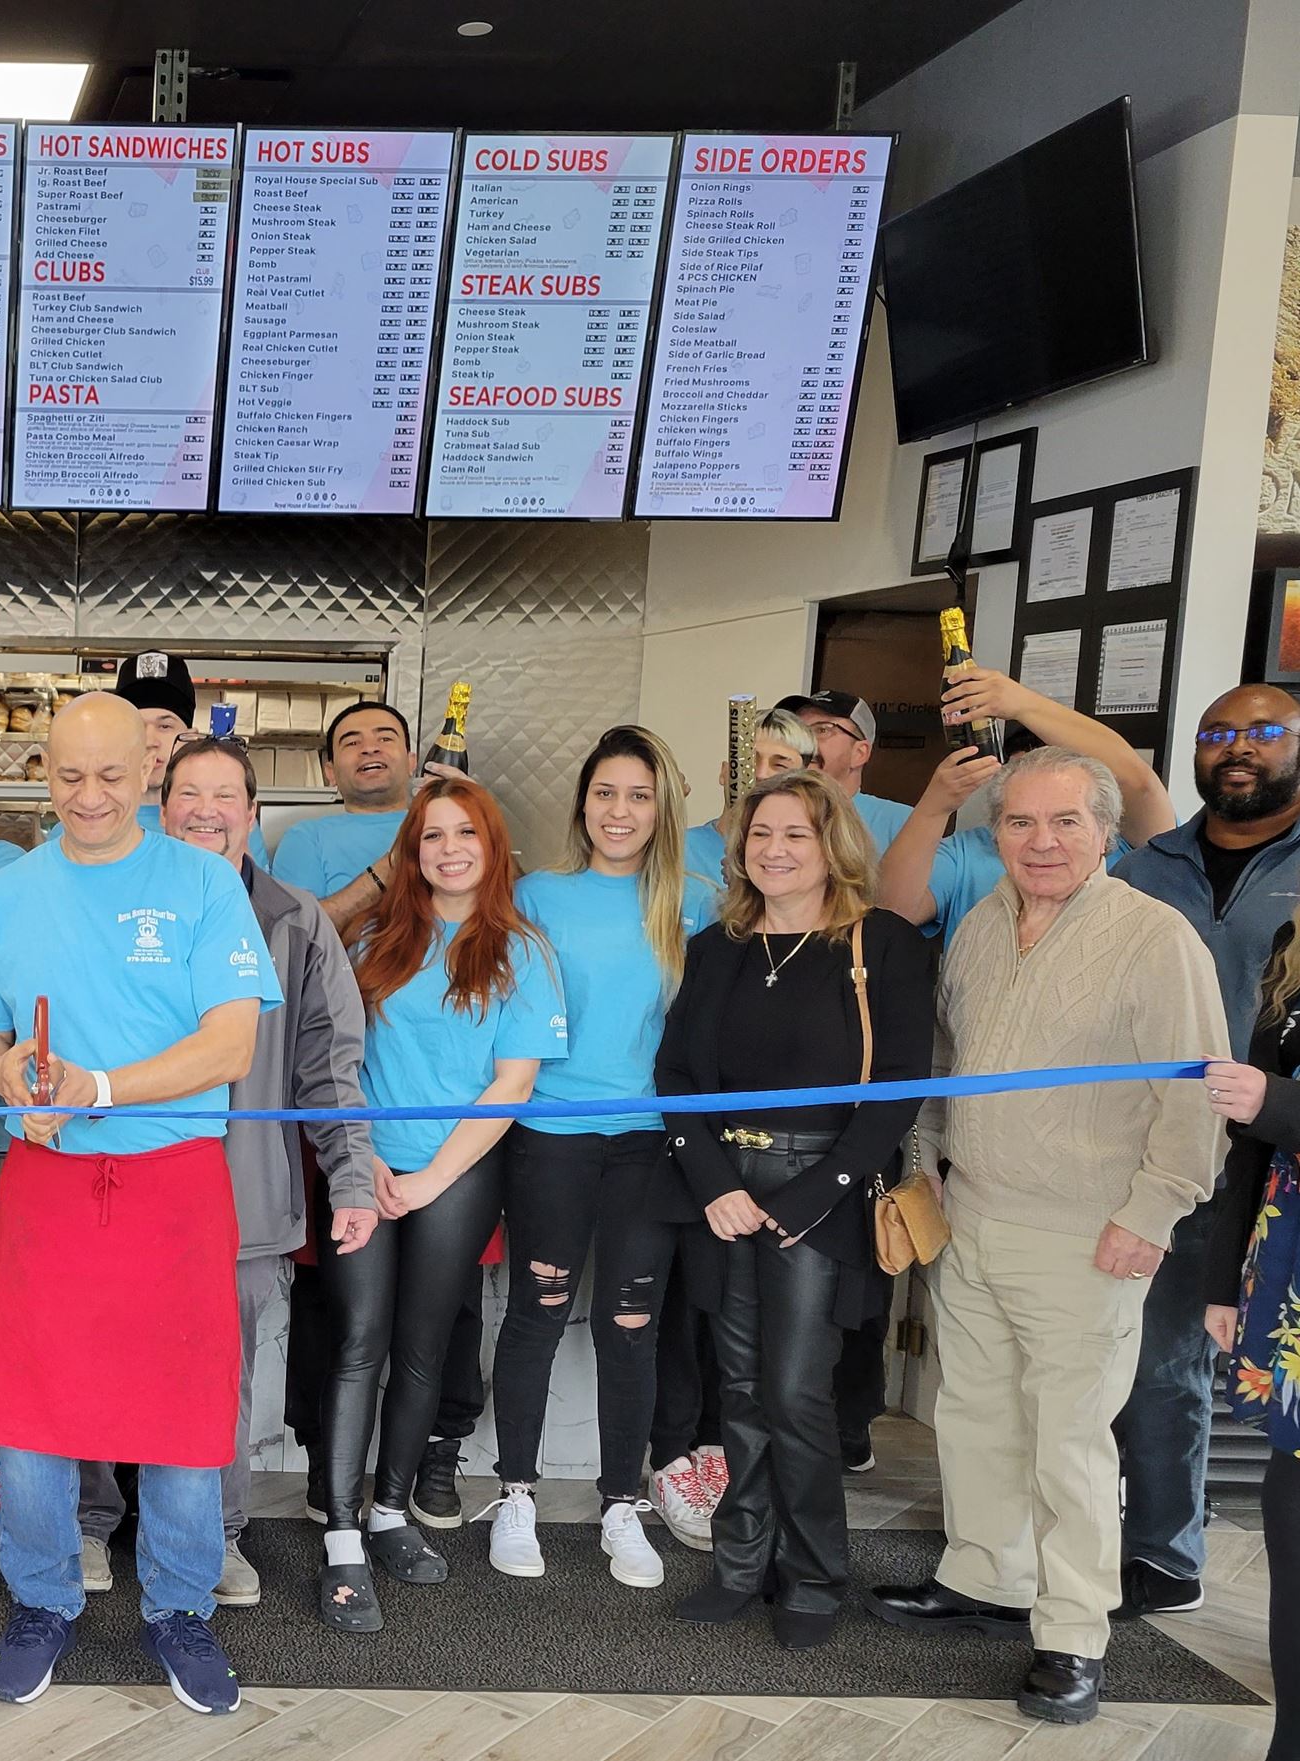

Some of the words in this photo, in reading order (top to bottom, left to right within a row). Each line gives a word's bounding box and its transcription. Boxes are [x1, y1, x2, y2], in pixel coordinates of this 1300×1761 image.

[40, 134, 83, 157] HOT
[88, 136, 228, 160] SANDWICHES
[258, 140, 305, 163] HOT
[311, 142, 370, 164] SUBS
[475, 148, 540, 171] COLD
[546, 149, 609, 172] SUBS
[694, 147, 754, 172] SIDE
[760, 148, 868, 174] ORDERS
[53, 166, 83, 176] Roast
[84, 166, 108, 176] Beef
[254, 174, 283, 186] Royal
[284, 175, 317, 185] House
[318, 175, 357, 186] Special
[358, 176, 378, 186] Sub
[470, 183, 502, 192] Italian
[690, 181, 720, 192] Onion
[722, 182, 751, 193] Rings
[469, 196, 518, 206] American
[687, 196, 716, 206] Pizza
[717, 196, 743, 206] Rolls
[468, 208, 505, 220] Turkey
[251, 217, 305, 226] Mushroom
[306, 217, 336, 227] Steak
[466, 222, 490, 231] Ham
[491, 222, 511, 231] and
[512, 222, 551, 232] Cheese
[34, 225, 76, 235] Chicken
[78, 226, 100, 236] Filet
[465, 235, 507, 245] Chicken
[508, 235, 537, 245] Salad
[34, 260, 106, 282] CLUBS
[188, 275, 214, 286] $15.99
[460, 274, 536, 296] STEAK
[540, 275, 601, 297] SUBS
[31, 301, 67, 314] Turkey
[68, 303, 92, 312] Club
[93, 303, 142, 313] Sandwich
[244, 301, 288, 311] Meatball
[670, 324, 718, 334] Coleslaw
[454, 331, 485, 342] Onion
[486, 332, 515, 341] Steak
[29, 360, 48, 370] BLT
[50, 360, 74, 372] Club
[75, 361, 123, 371] Sandwich
[665, 363, 701, 373] French
[702, 364, 728, 373] Fries
[663, 377, 690, 386] Fried
[691, 377, 750, 387] Mushrooms
[28, 383, 99, 404] PASTA
[238, 383, 258, 393] BLT
[259, 384, 279, 393] Sub
[448, 386, 557, 406] SEAFOOD
[563, 386, 622, 407] SUBS
[662, 389, 703, 399] Broccoli
[704, 390, 724, 399] and
[725, 390, 769, 399] Cheddar
[444, 428, 469, 438] Tuna
[470, 429, 490, 438] Sub
[234, 437, 274, 446] Chicken
[276, 437, 311, 447] Caesar
[312, 437, 339, 448] Wrap
[440, 464, 465, 474] Clam
[466, 465, 486, 474] Roll
[730, 708, 739, 780] CONFETTIS
